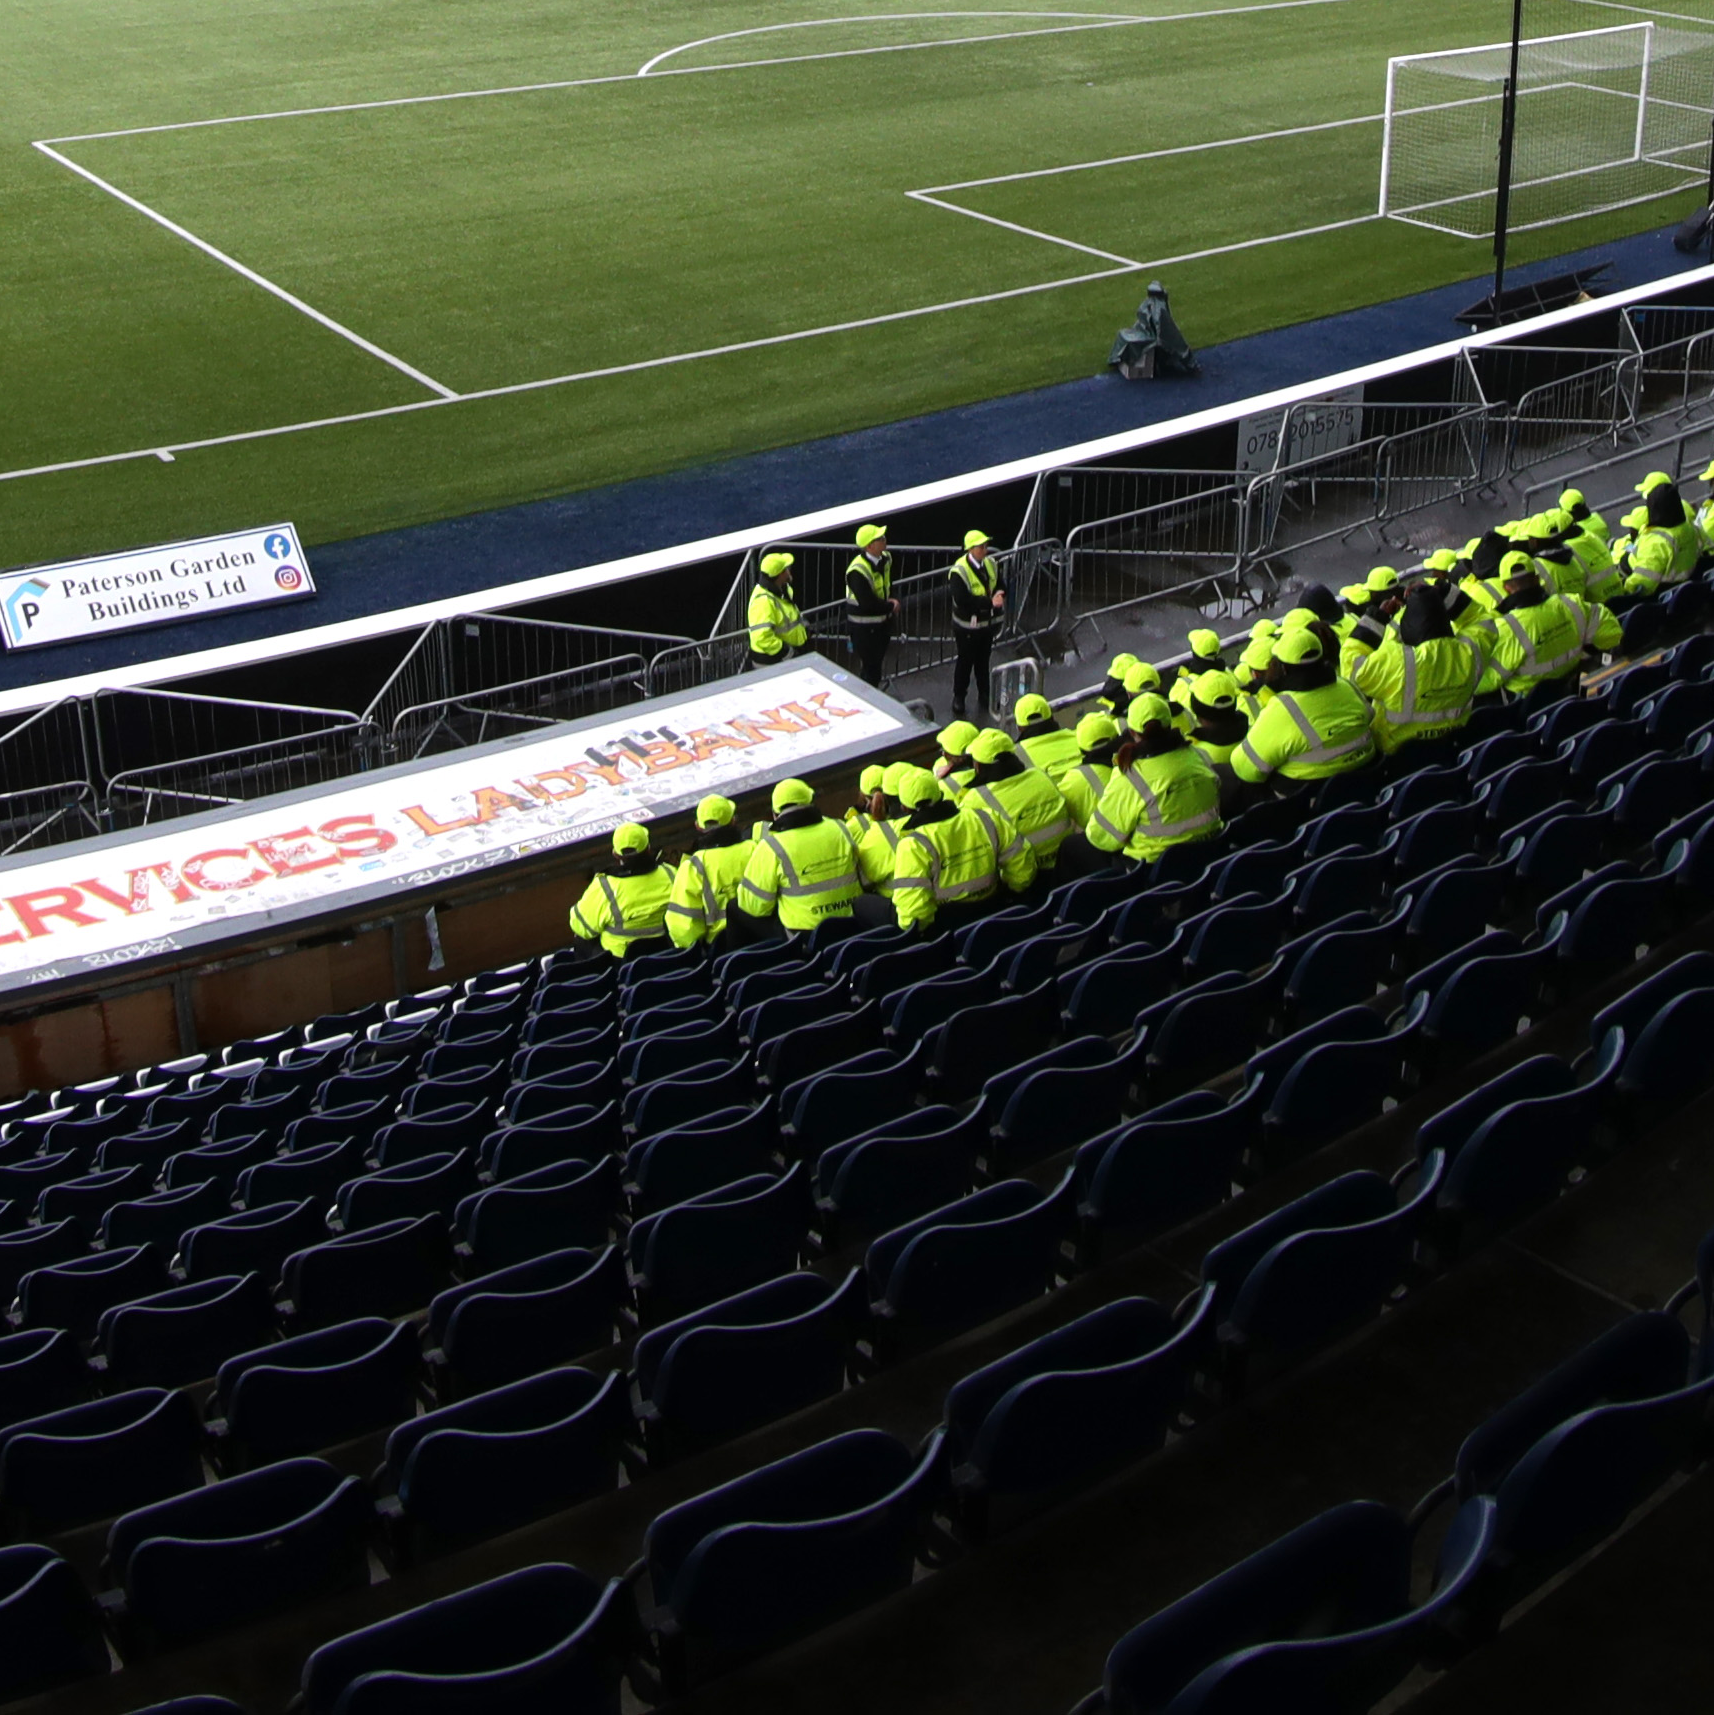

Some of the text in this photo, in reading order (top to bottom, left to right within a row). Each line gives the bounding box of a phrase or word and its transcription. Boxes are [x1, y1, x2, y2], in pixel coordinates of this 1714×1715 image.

[1247, 410, 1354, 456] 0782015575
[60, 549, 257, 599] Paterson Garden
[87, 575, 247, 622] Buildings Ltd
[400, 691, 862, 837] LADYBANK
[810, 896, 855, 916] STEWAR
